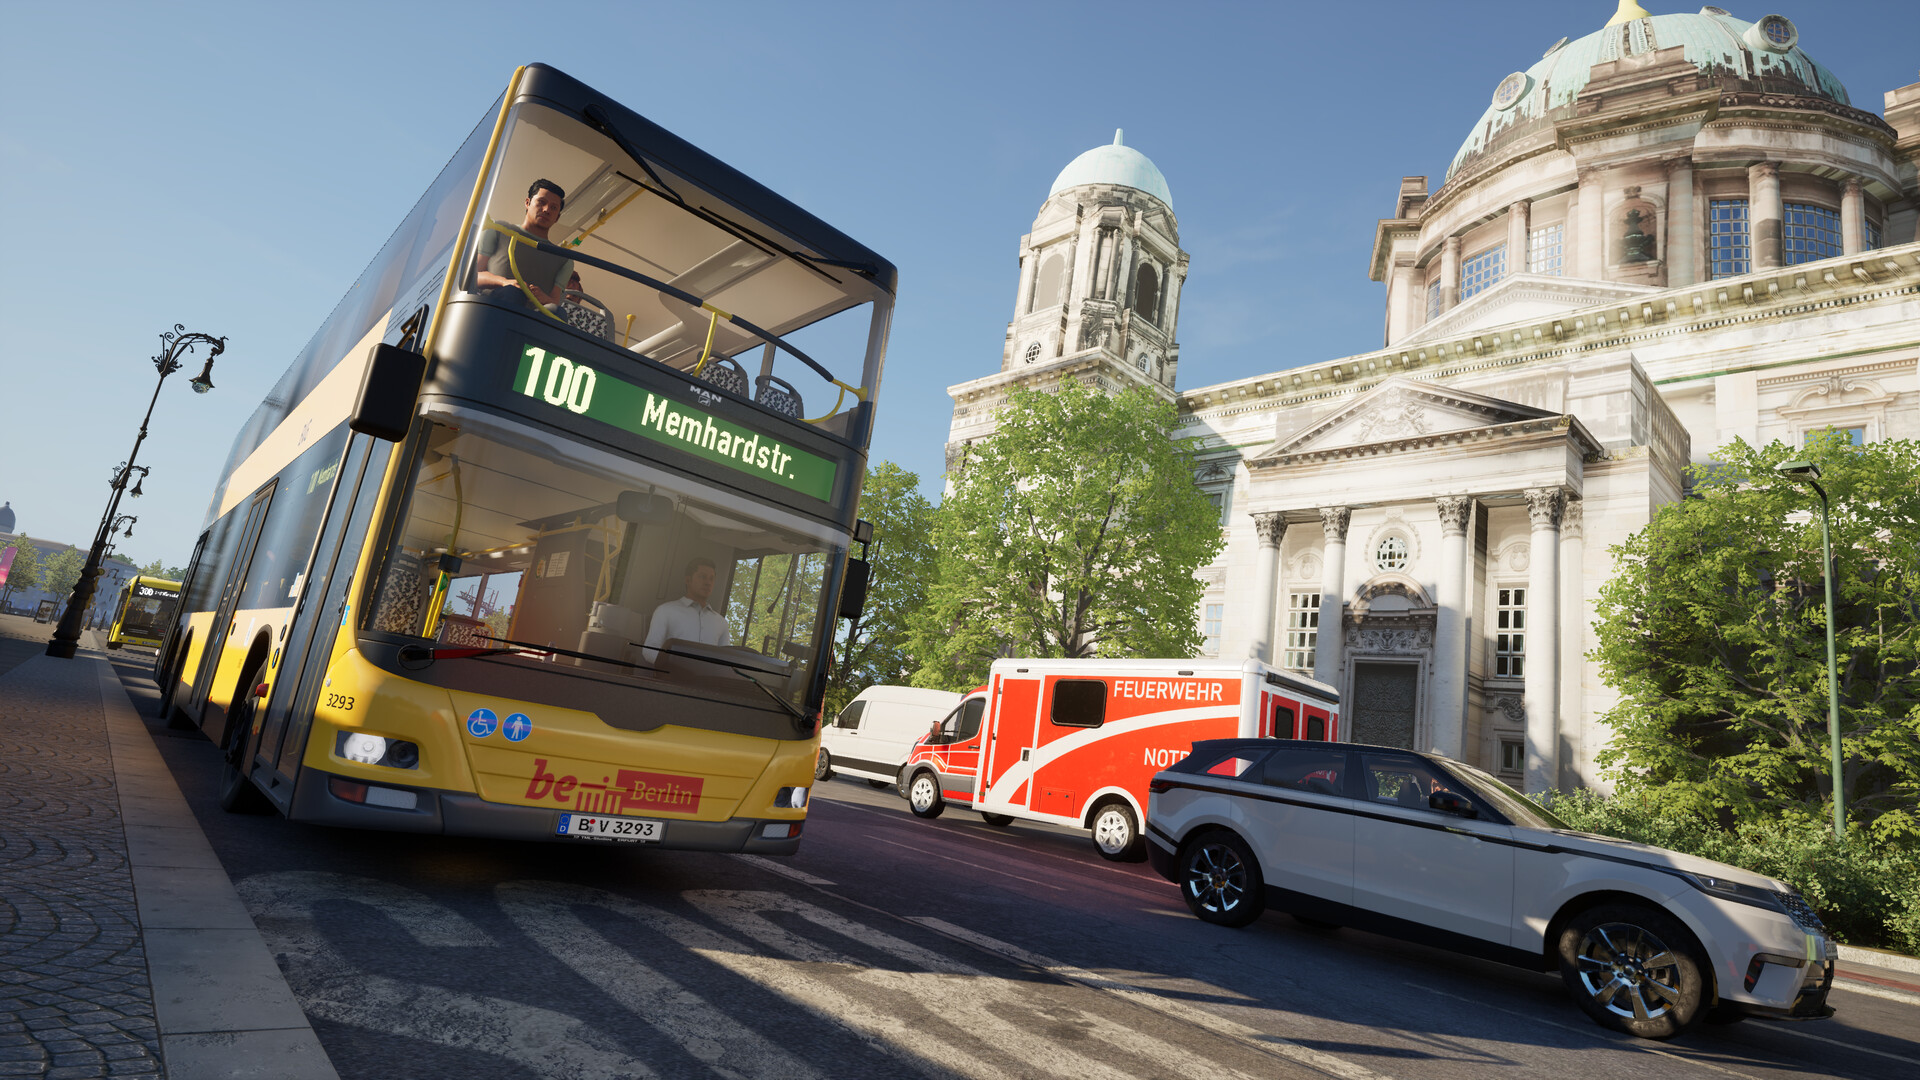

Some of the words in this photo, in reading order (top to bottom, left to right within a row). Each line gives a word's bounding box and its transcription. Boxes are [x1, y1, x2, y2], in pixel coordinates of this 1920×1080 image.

[690, 385, 722, 403] MAN
[523, 347, 597, 414] 100
[641, 393, 795, 480] Memhardstr.
[1114, 680, 1223, 702] FEUERWEHR
[326, 693, 355, 711] 3293
[525, 758, 578, 803] be
[630, 780, 694, 806] Berlin
[578, 818, 590, 831] B
[599, 820, 610, 833] V
[612, 821, 654, 836] 3293
